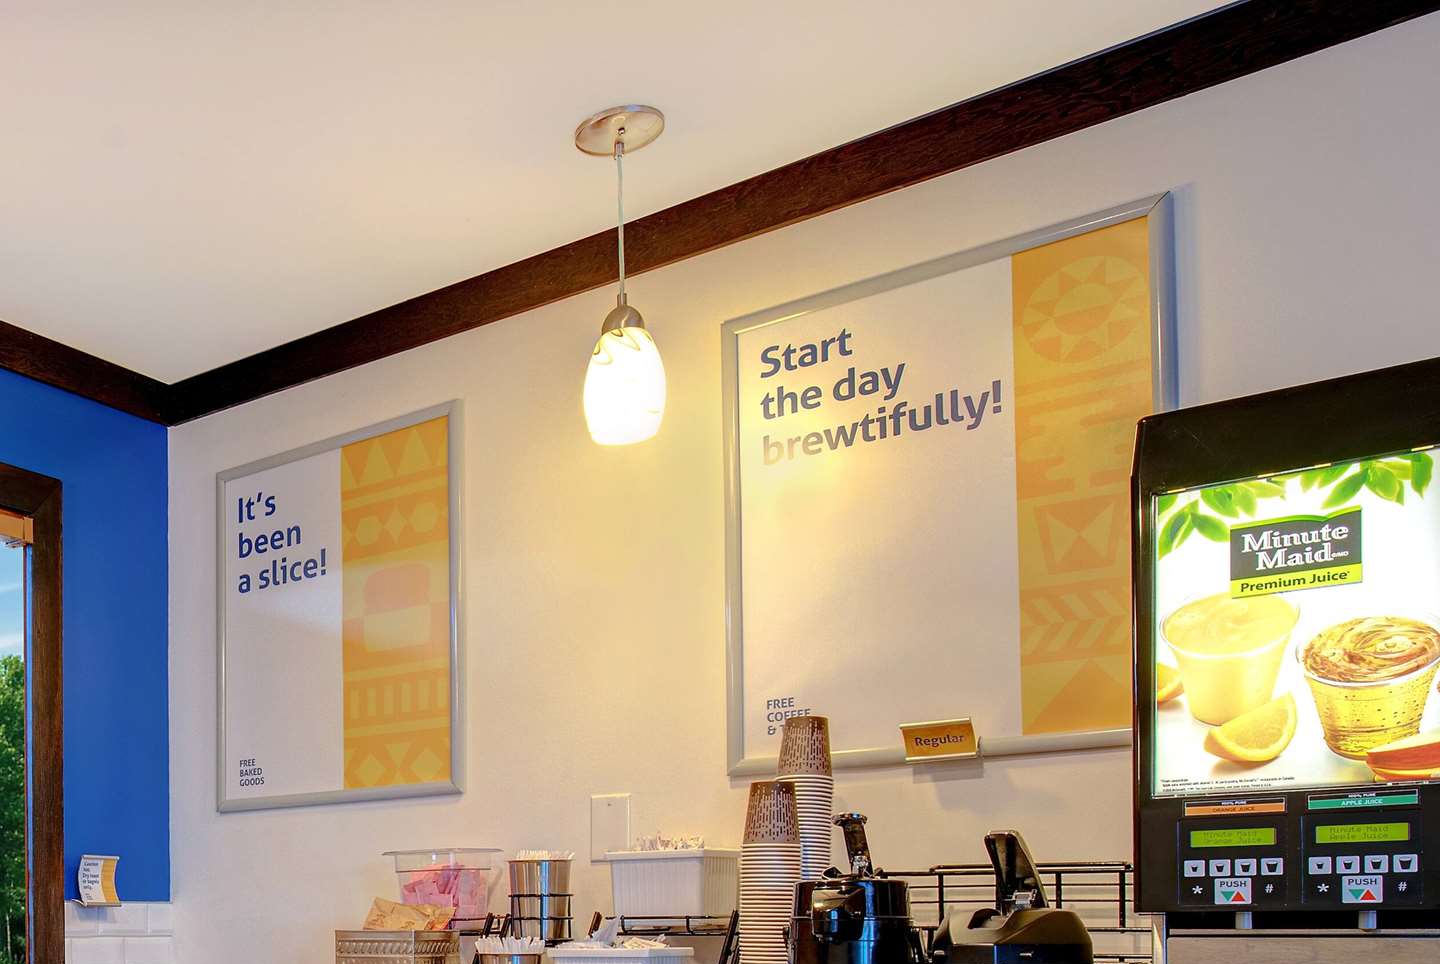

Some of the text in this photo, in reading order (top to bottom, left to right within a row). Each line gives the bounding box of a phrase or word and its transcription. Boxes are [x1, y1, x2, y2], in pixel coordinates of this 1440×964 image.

[760, 327, 853, 378] Start
[760, 362, 906, 420] the day
[762, 380, 1002, 466] brewtifully!
[238, 492, 276, 523] It's
[238, 525, 301, 558] been
[1241, 523, 1349, 553] Minute
[1255, 543, 1334, 571] Maid
[238, 548, 327, 594] a slice!
[1240, 577, 1306, 593] Premium
[767, 697, 794, 710] FREE
[767, 725, 776, 735] &
[914, 733, 965, 748] Regular
[239, 758, 256, 768] FREE
[239, 768, 263, 777] BAKED
[239, 777, 265, 786] GOODS
[1219, 880, 1247, 888] PUSH
[1347, 877, 1377, 886] PUSH
